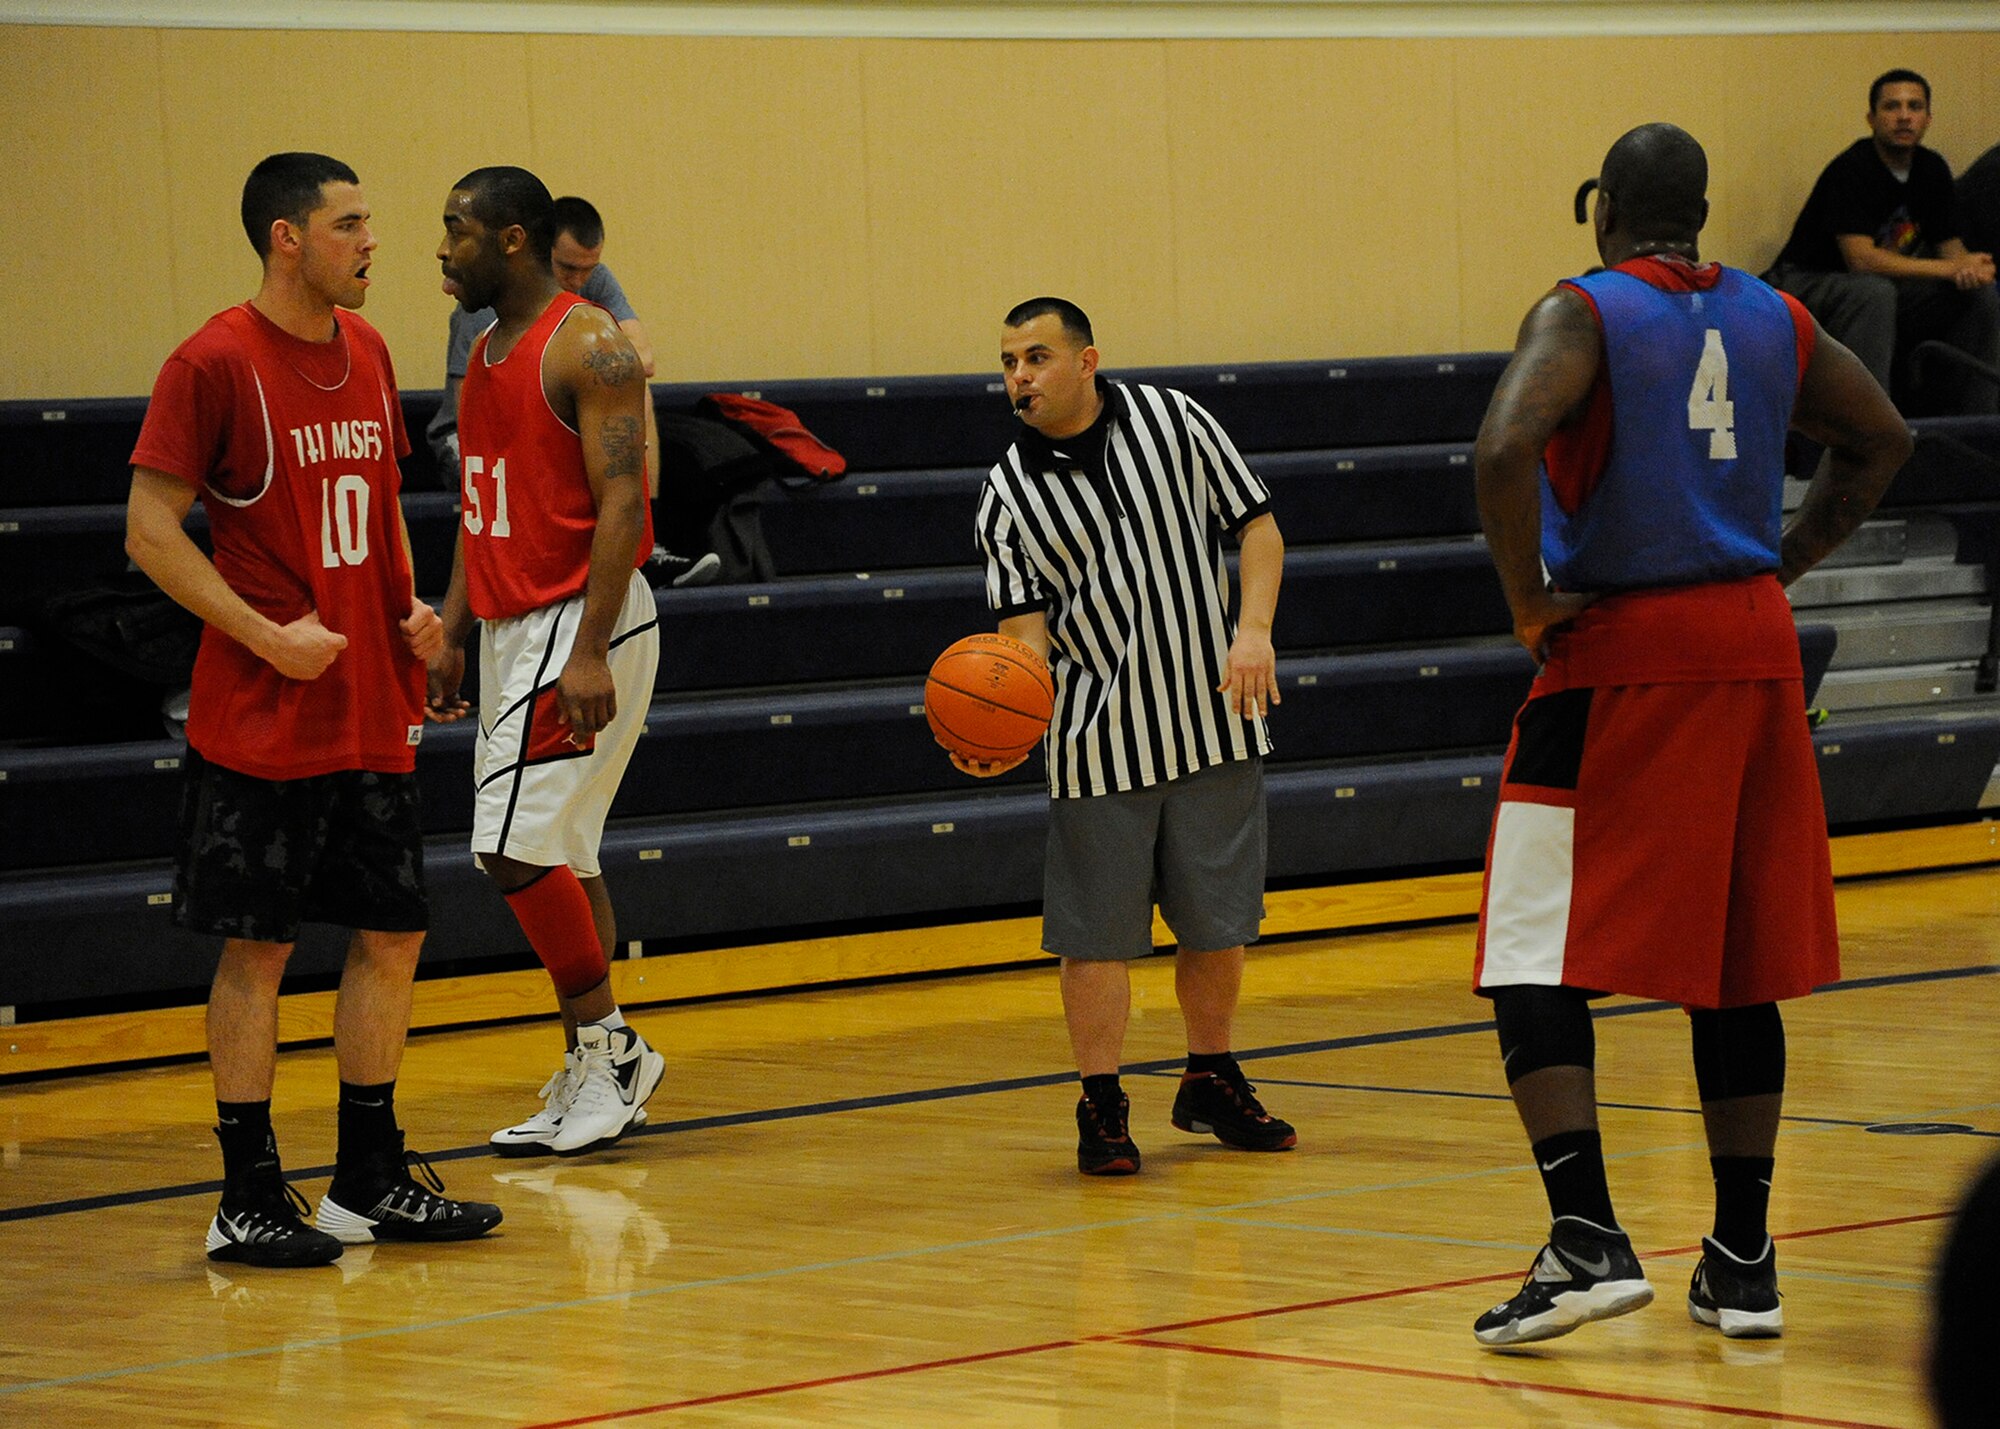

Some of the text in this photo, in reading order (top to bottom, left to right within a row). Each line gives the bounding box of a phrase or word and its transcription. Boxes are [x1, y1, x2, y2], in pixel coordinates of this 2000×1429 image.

[1688, 329, 1737, 459] 4
[331, 420, 383, 461] MSFS
[322, 475, 370, 568] 10
[464, 457, 511, 536] 51
